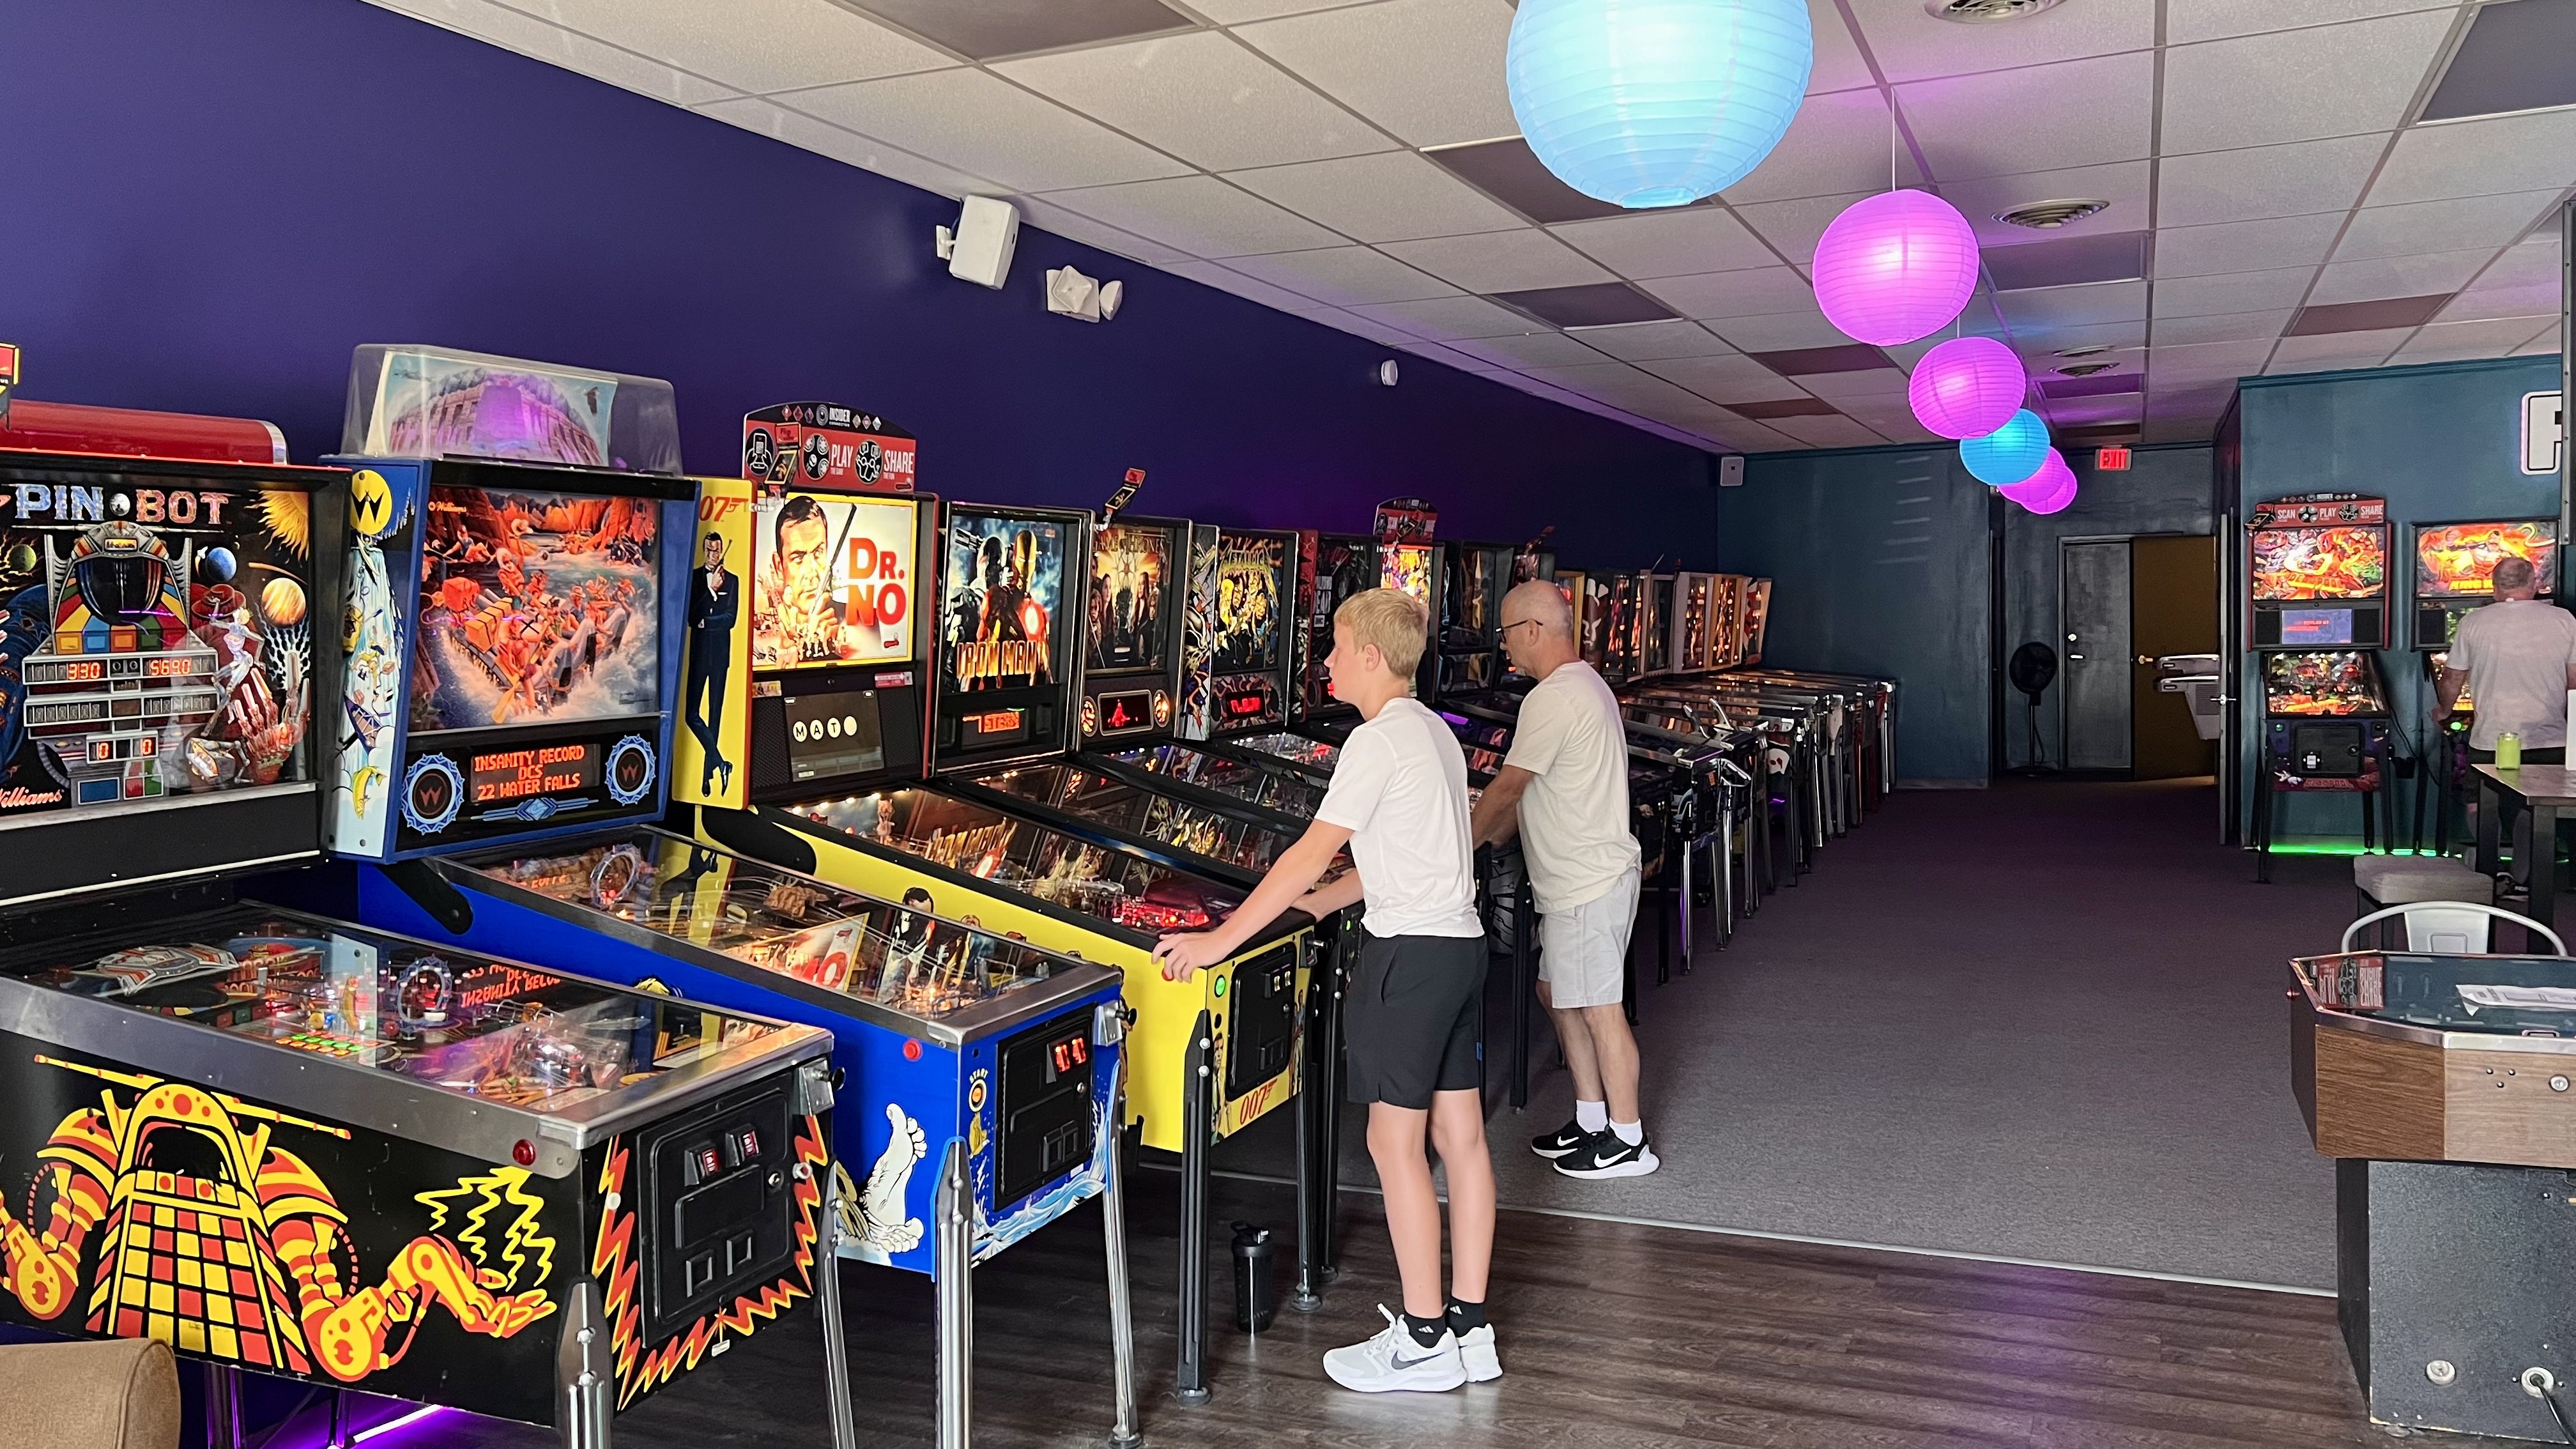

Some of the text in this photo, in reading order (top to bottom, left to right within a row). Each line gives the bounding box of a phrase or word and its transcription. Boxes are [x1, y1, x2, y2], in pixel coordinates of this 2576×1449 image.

[829, 407, 850, 423] INSIDER
[831, 444, 854, 468] PLAY
[884, 450, 914, 474] SHARE
[2103, 449, 2127, 469] EXIT
[13, 483, 231, 525] PIN BOT
[2277, 509, 2296, 519] SCAN
[2319, 507, 2337, 518] PLAY
[2360, 505, 2384, 516] SHARE
[848, 537, 905, 580] DR.
[845, 583, 907, 627] NO
[68, 661, 100, 680] 330
[150, 658, 192, 676] 5690
[956, 641, 1038, 678] IRON MAN
[475, 745, 585, 772] INSANITY RECORD
[518, 763, 543, 781] DCS
[477, 773, 581, 801] 22 WATER FALLS
[969, 1068, 988, 1084] START
[1239, 1081, 1274, 1125] 007
